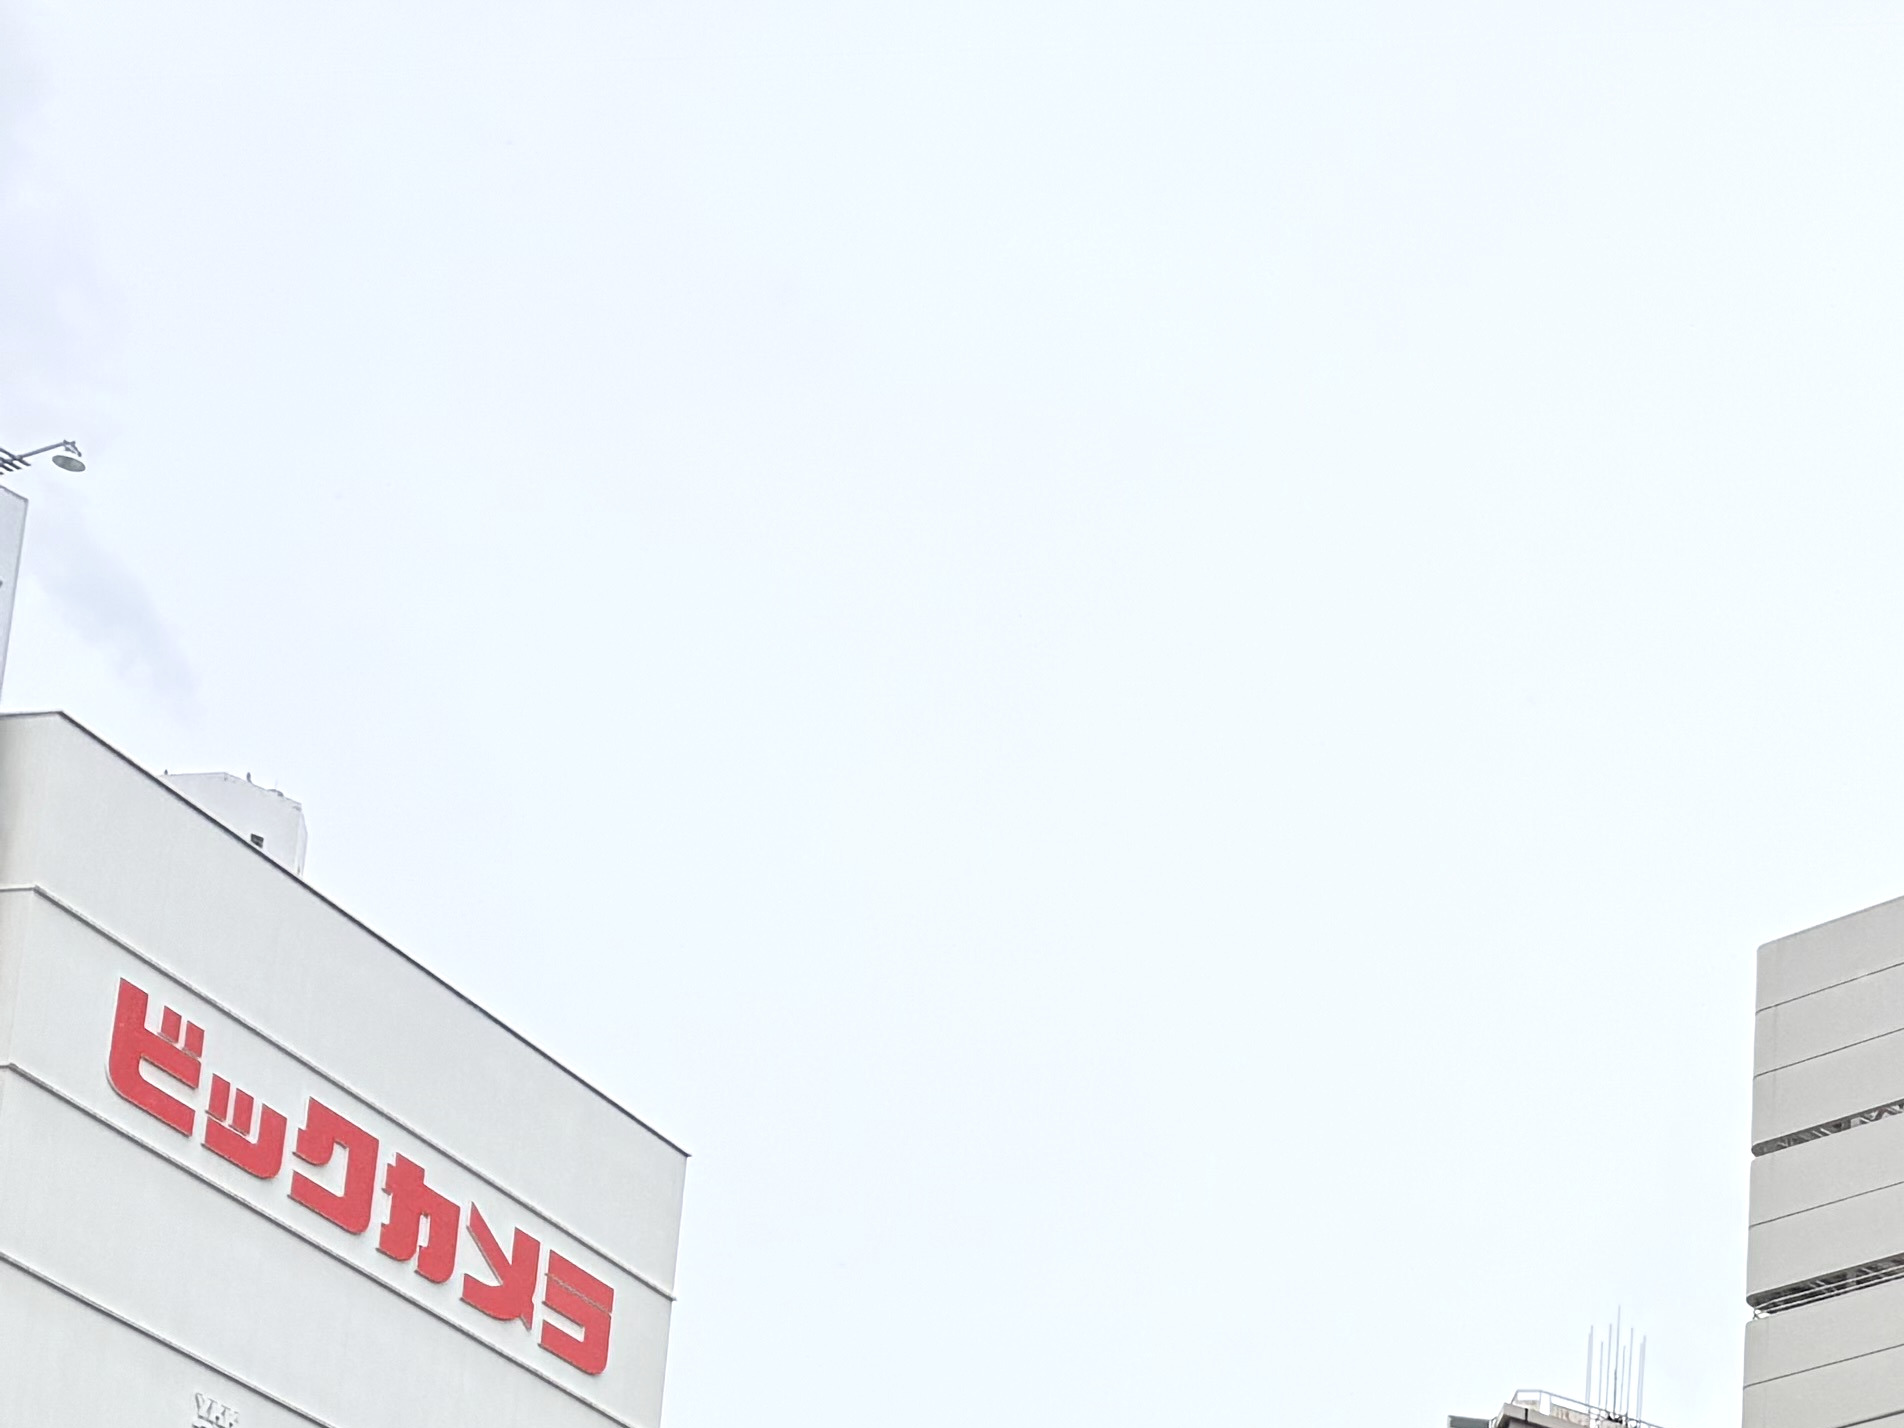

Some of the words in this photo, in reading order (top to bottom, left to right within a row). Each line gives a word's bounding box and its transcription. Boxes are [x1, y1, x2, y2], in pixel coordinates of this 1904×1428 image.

[107, 977, 614, 1375] ビックカメラ
